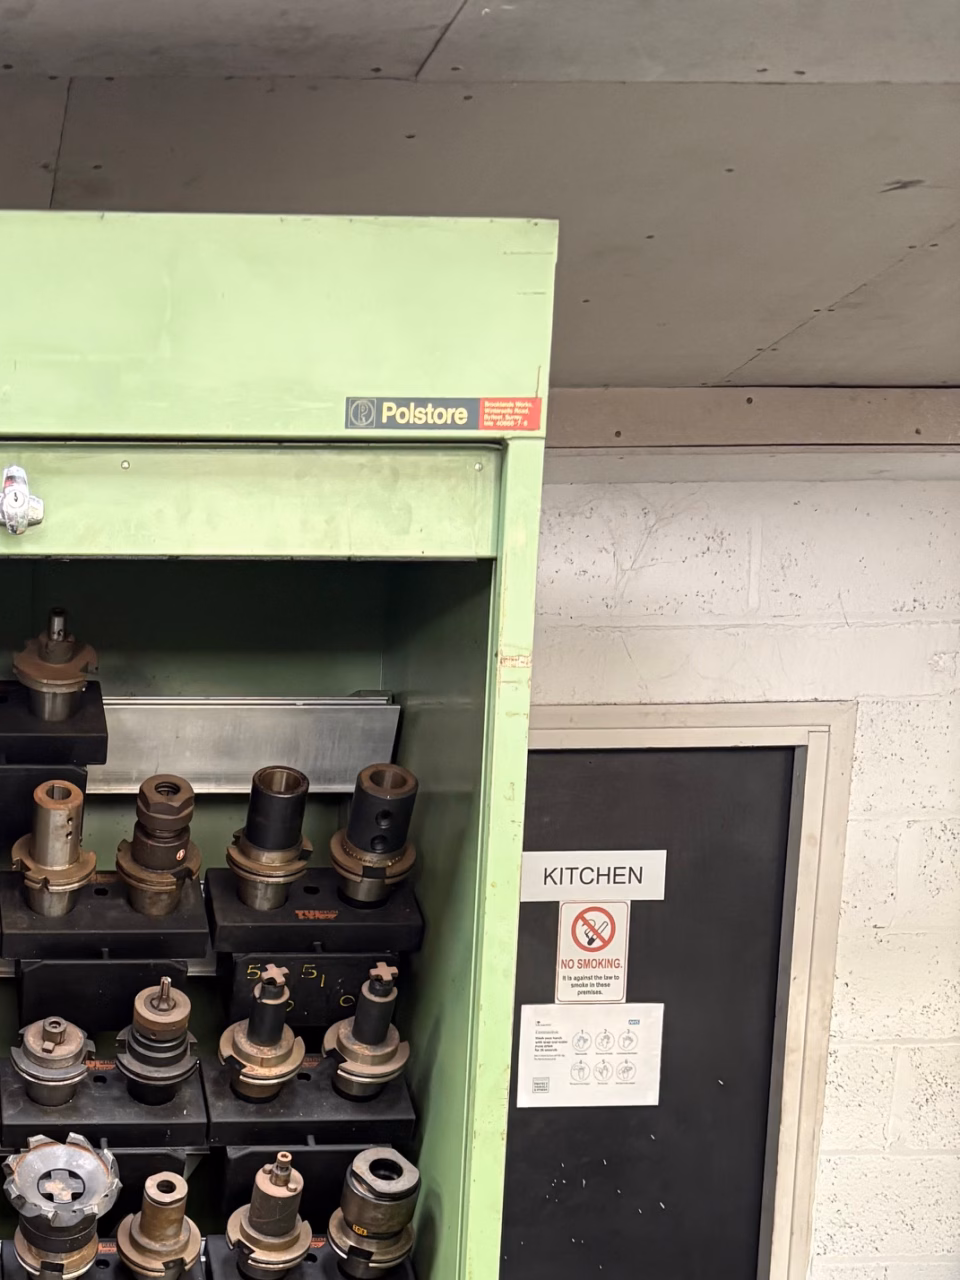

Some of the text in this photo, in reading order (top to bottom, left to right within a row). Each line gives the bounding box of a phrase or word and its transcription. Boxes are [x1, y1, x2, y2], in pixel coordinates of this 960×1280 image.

[382, 402, 468, 424] Polstore
[544, 866, 643, 885] KITCHEN
[561, 958, 623, 969] NO SMOKING.
